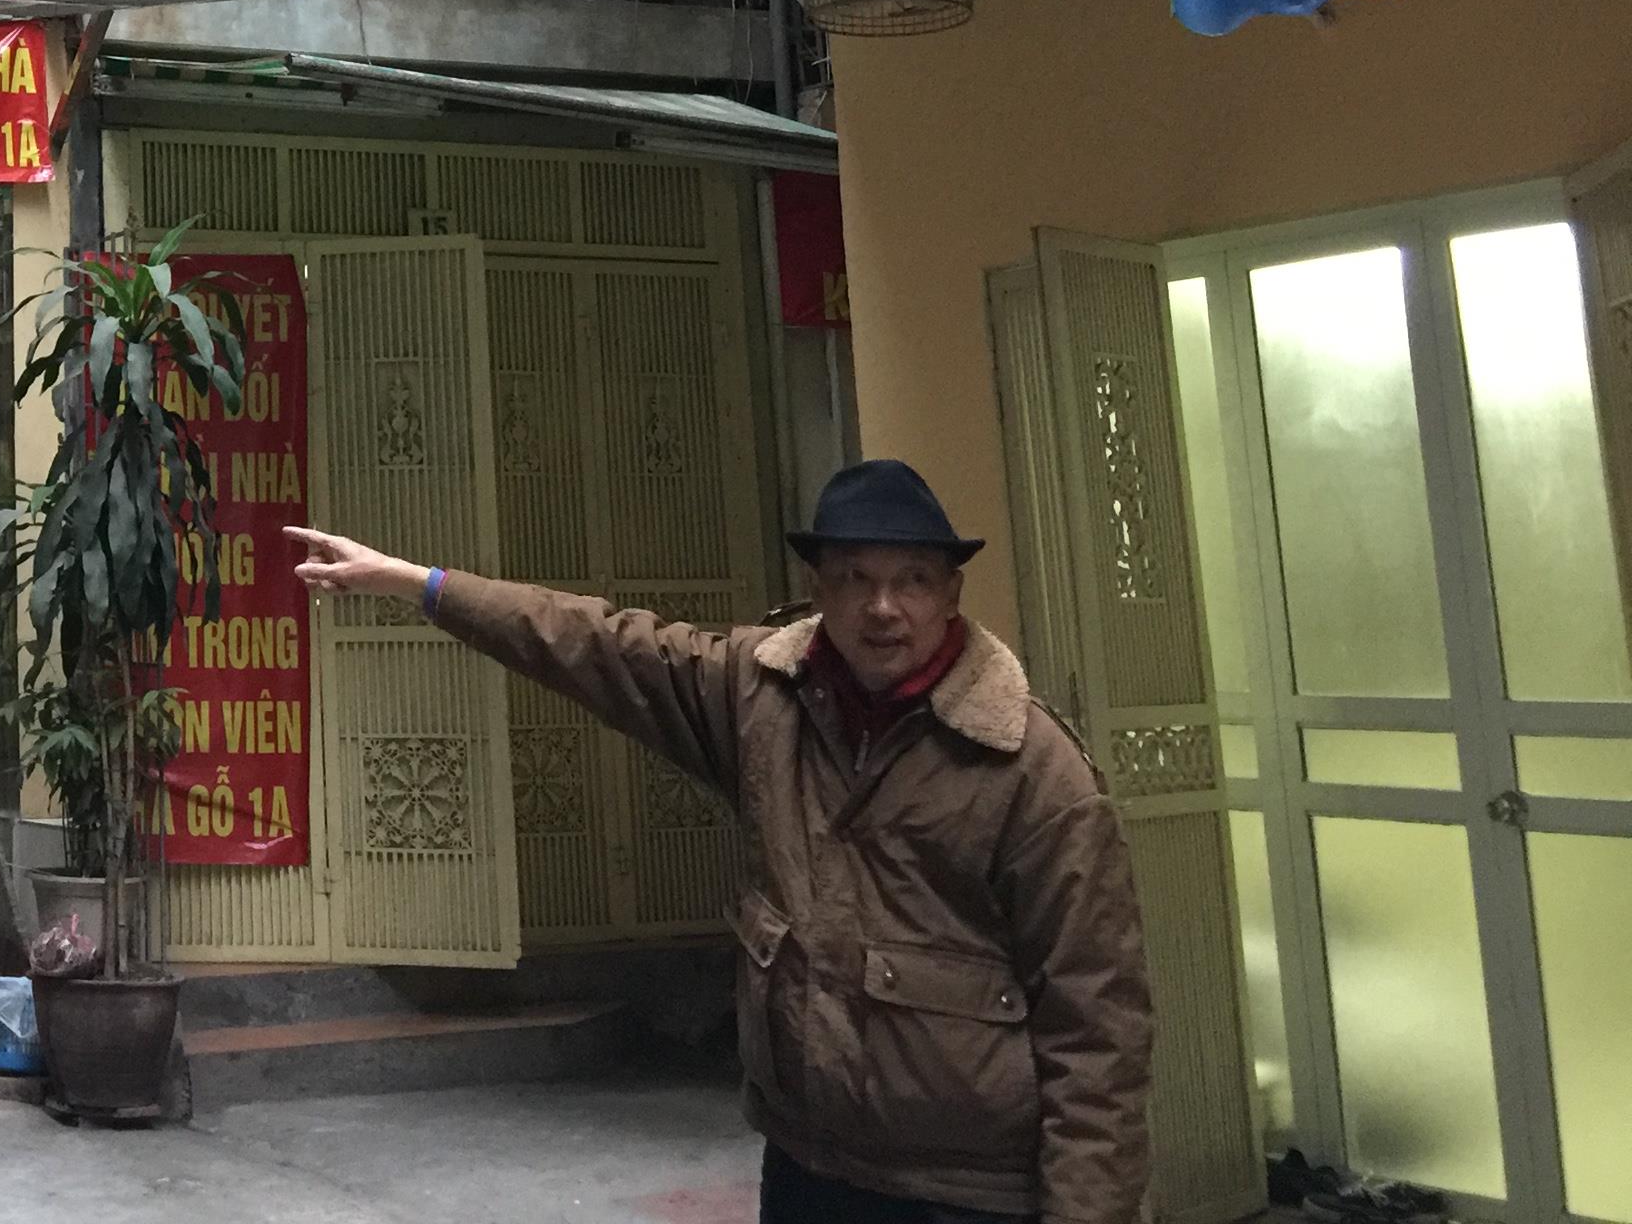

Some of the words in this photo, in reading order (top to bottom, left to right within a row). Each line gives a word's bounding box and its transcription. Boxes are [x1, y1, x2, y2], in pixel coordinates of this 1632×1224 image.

[1, 119, 41, 168] 1A
[231, 441, 302, 504] NHÀ
[183, 616, 299, 670] TRONG
[222, 688, 302, 754] VIÊN
[187, 765, 235, 838] GỖ
[248, 786, 294, 838] 1A
